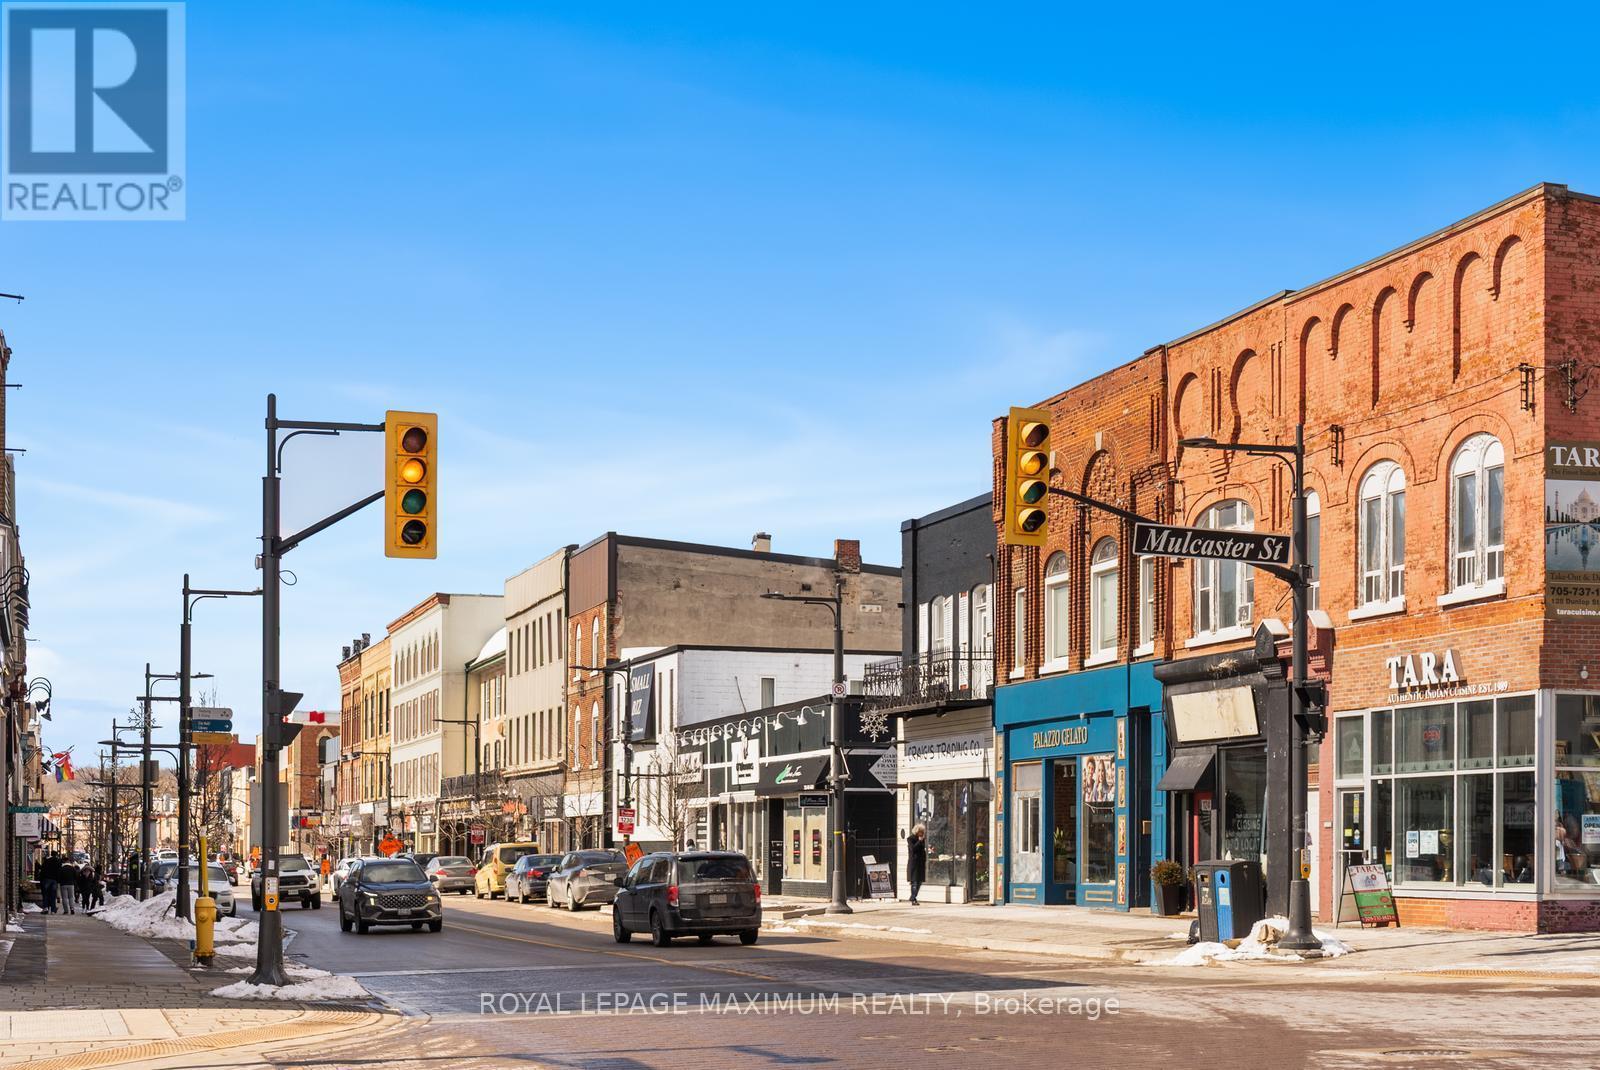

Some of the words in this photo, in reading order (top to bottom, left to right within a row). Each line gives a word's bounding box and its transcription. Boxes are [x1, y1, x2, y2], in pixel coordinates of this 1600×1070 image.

[1550, 446, 1600, 467] TAR
[1143, 528, 1254, 558] Mulcaster
[1258, 537, 1283, 561] St
[1550, 586, 1600, 597] 705-737-1
[1386, 648, 1460, 689] TARA
[631, 672, 650, 693] SMALL
[1425, 687, 1449, 699] INDIAN
[1449, 684, 1478, 697] CUISINE
[1033, 730, 1061, 750] PALAZZO
[1061, 726, 1088, 746] GELATO
[908, 744, 935, 762] CRAIG'S
[936, 741, 968, 760] TRADING
[969, 739, 983, 757] CO.
